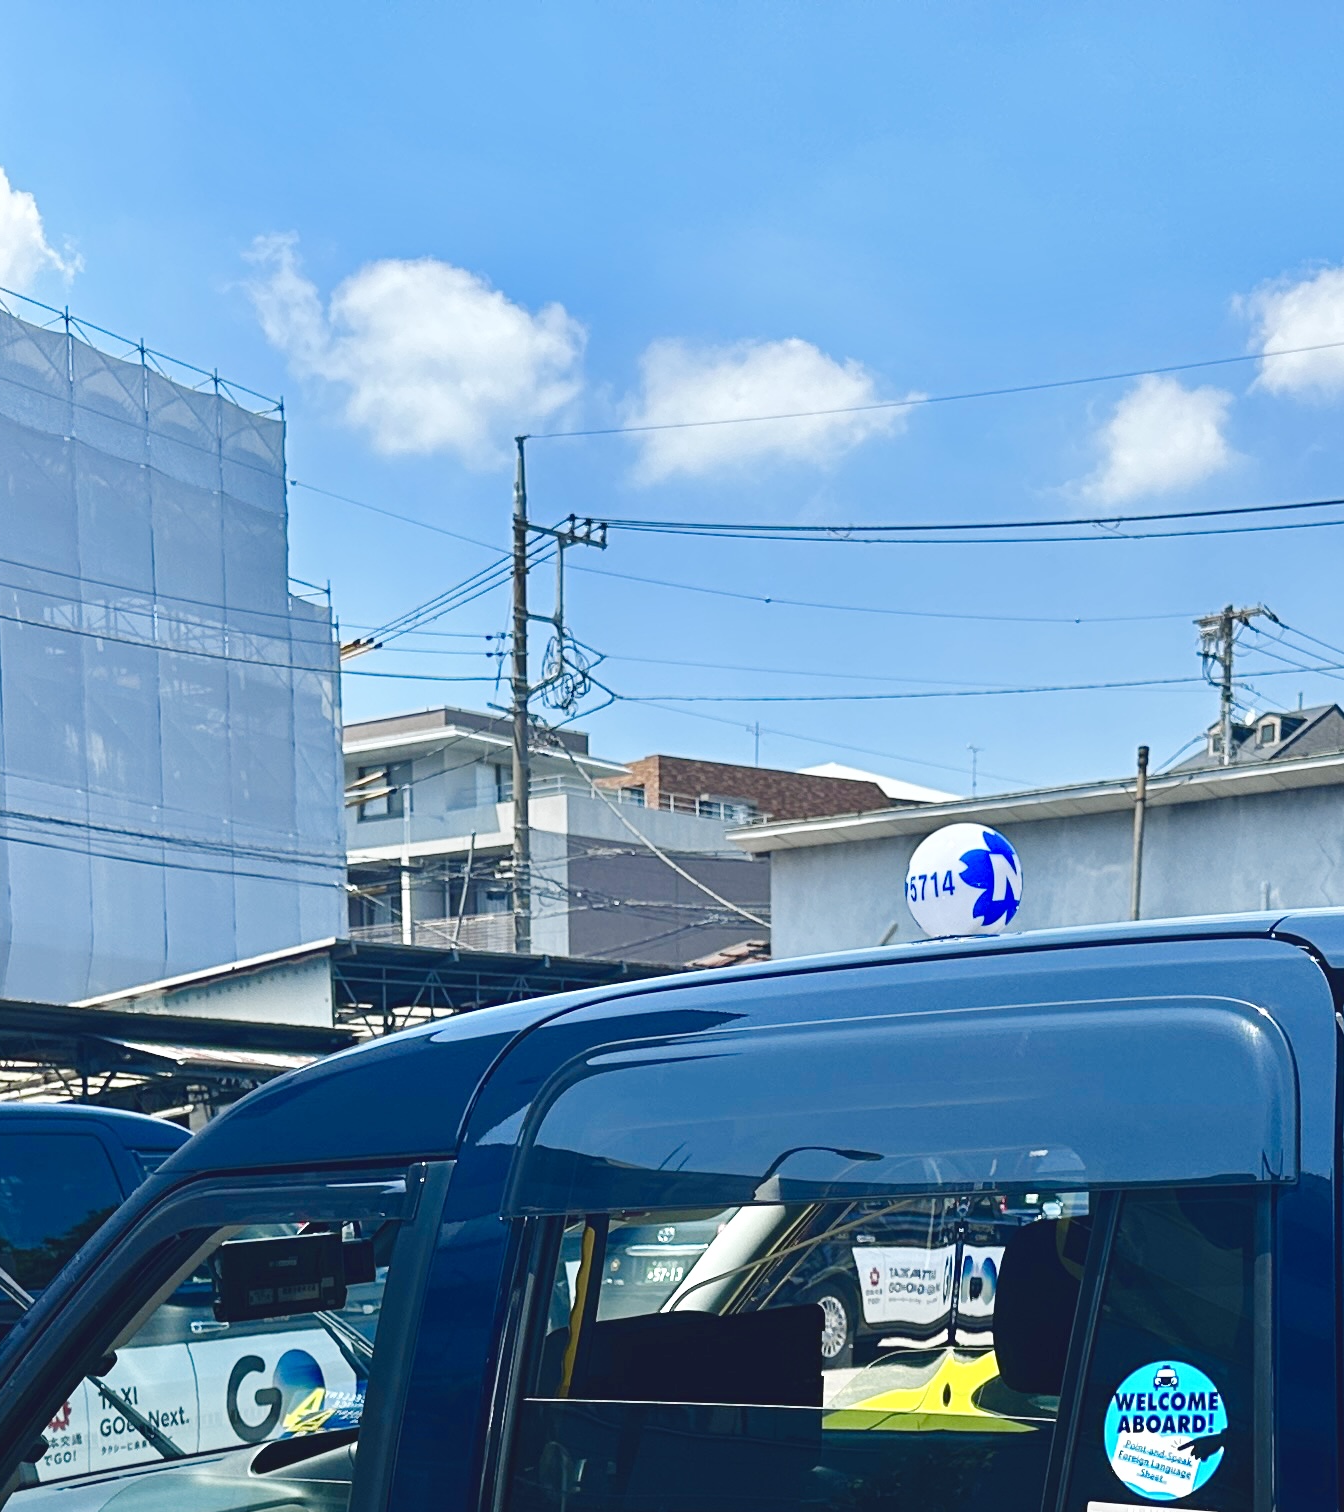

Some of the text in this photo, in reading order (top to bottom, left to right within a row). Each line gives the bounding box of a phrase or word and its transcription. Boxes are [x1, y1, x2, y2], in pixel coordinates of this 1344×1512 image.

[910, 869, 955, 903] 5714
[1115, 1391, 1219, 1411] WELCOME
[100, 1416, 138, 1438] GOe
[1117, 1413, 1214, 1433] ABOARD!
[47, 1433, 83, 1449] 本交通
[44, 1451, 77, 1467] でGO!
[1118, 1450, 1192, 1480] Foreign Language
